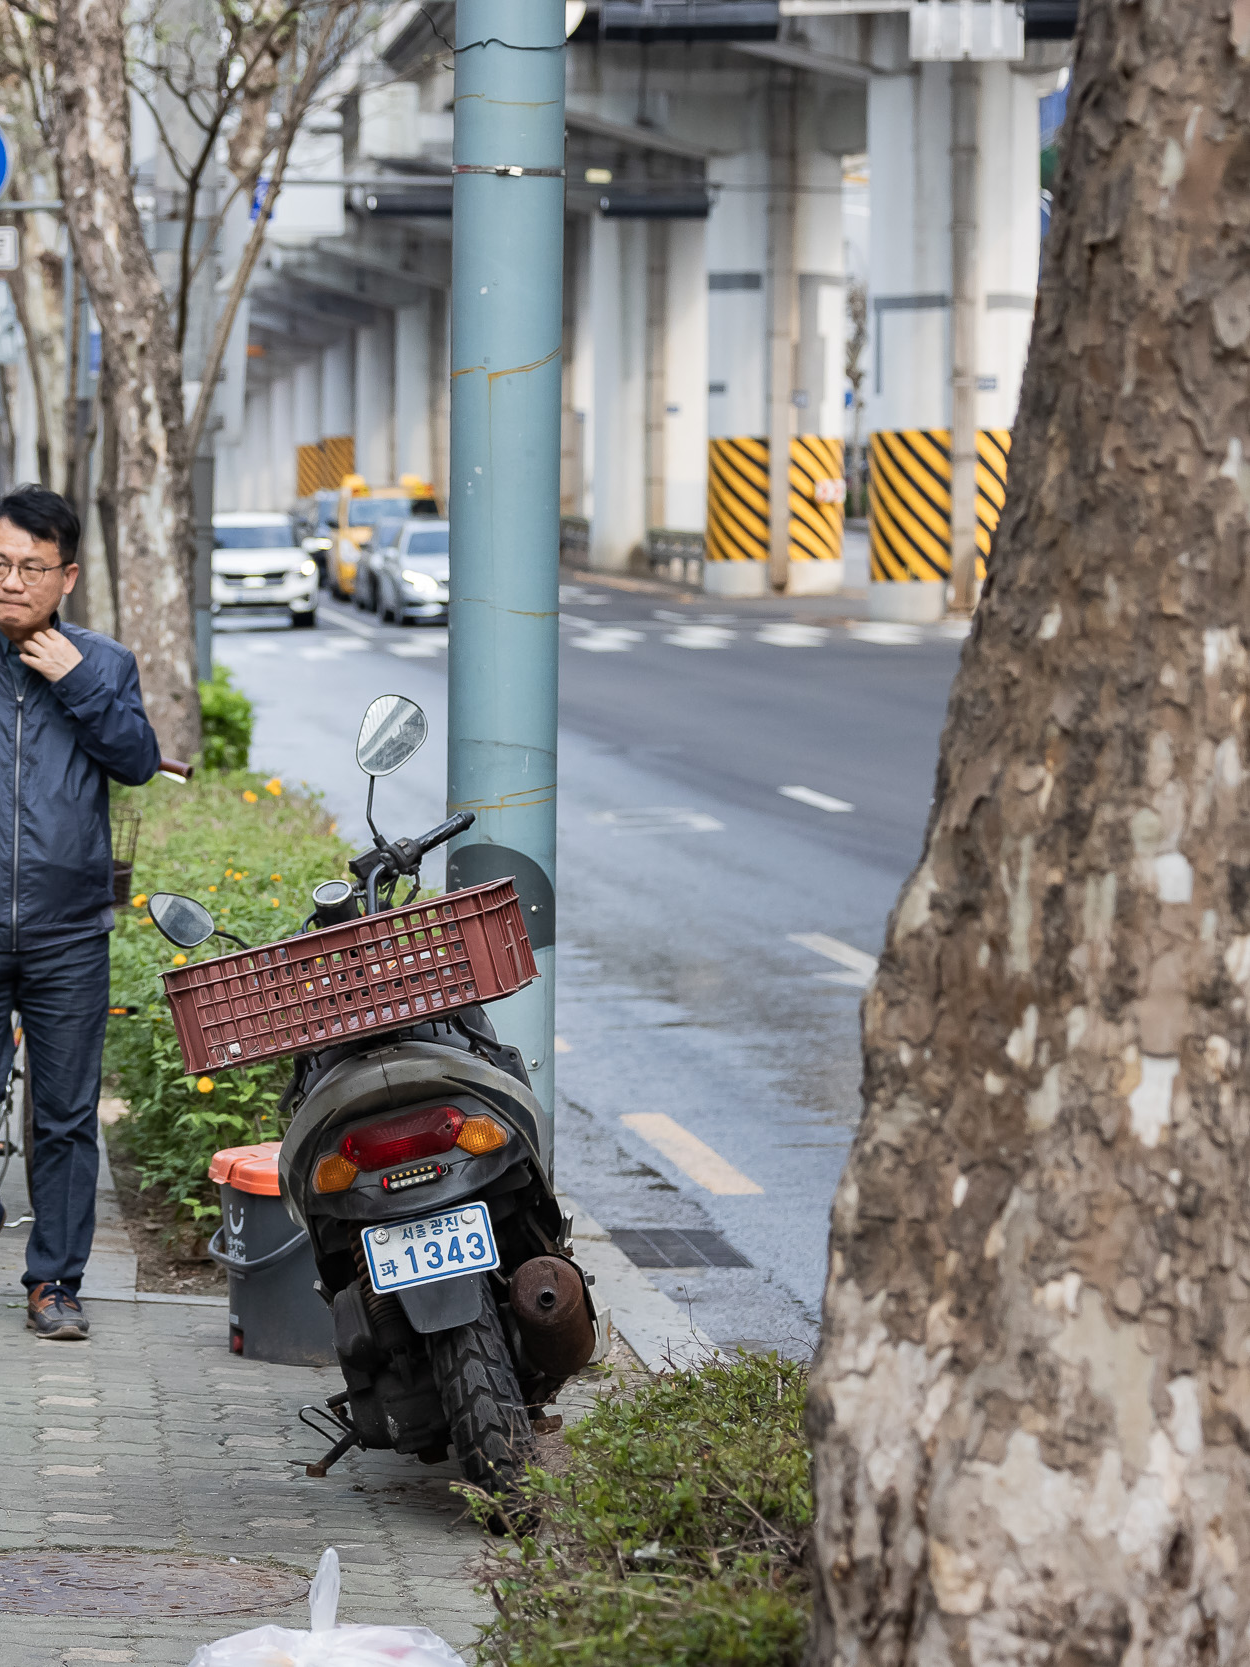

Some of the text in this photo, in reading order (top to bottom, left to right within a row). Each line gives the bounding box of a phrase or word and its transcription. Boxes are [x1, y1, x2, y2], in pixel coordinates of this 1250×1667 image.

[402, 1215, 460, 1240] 서울 광진
[379, 1232, 486, 1278] 파 1343
